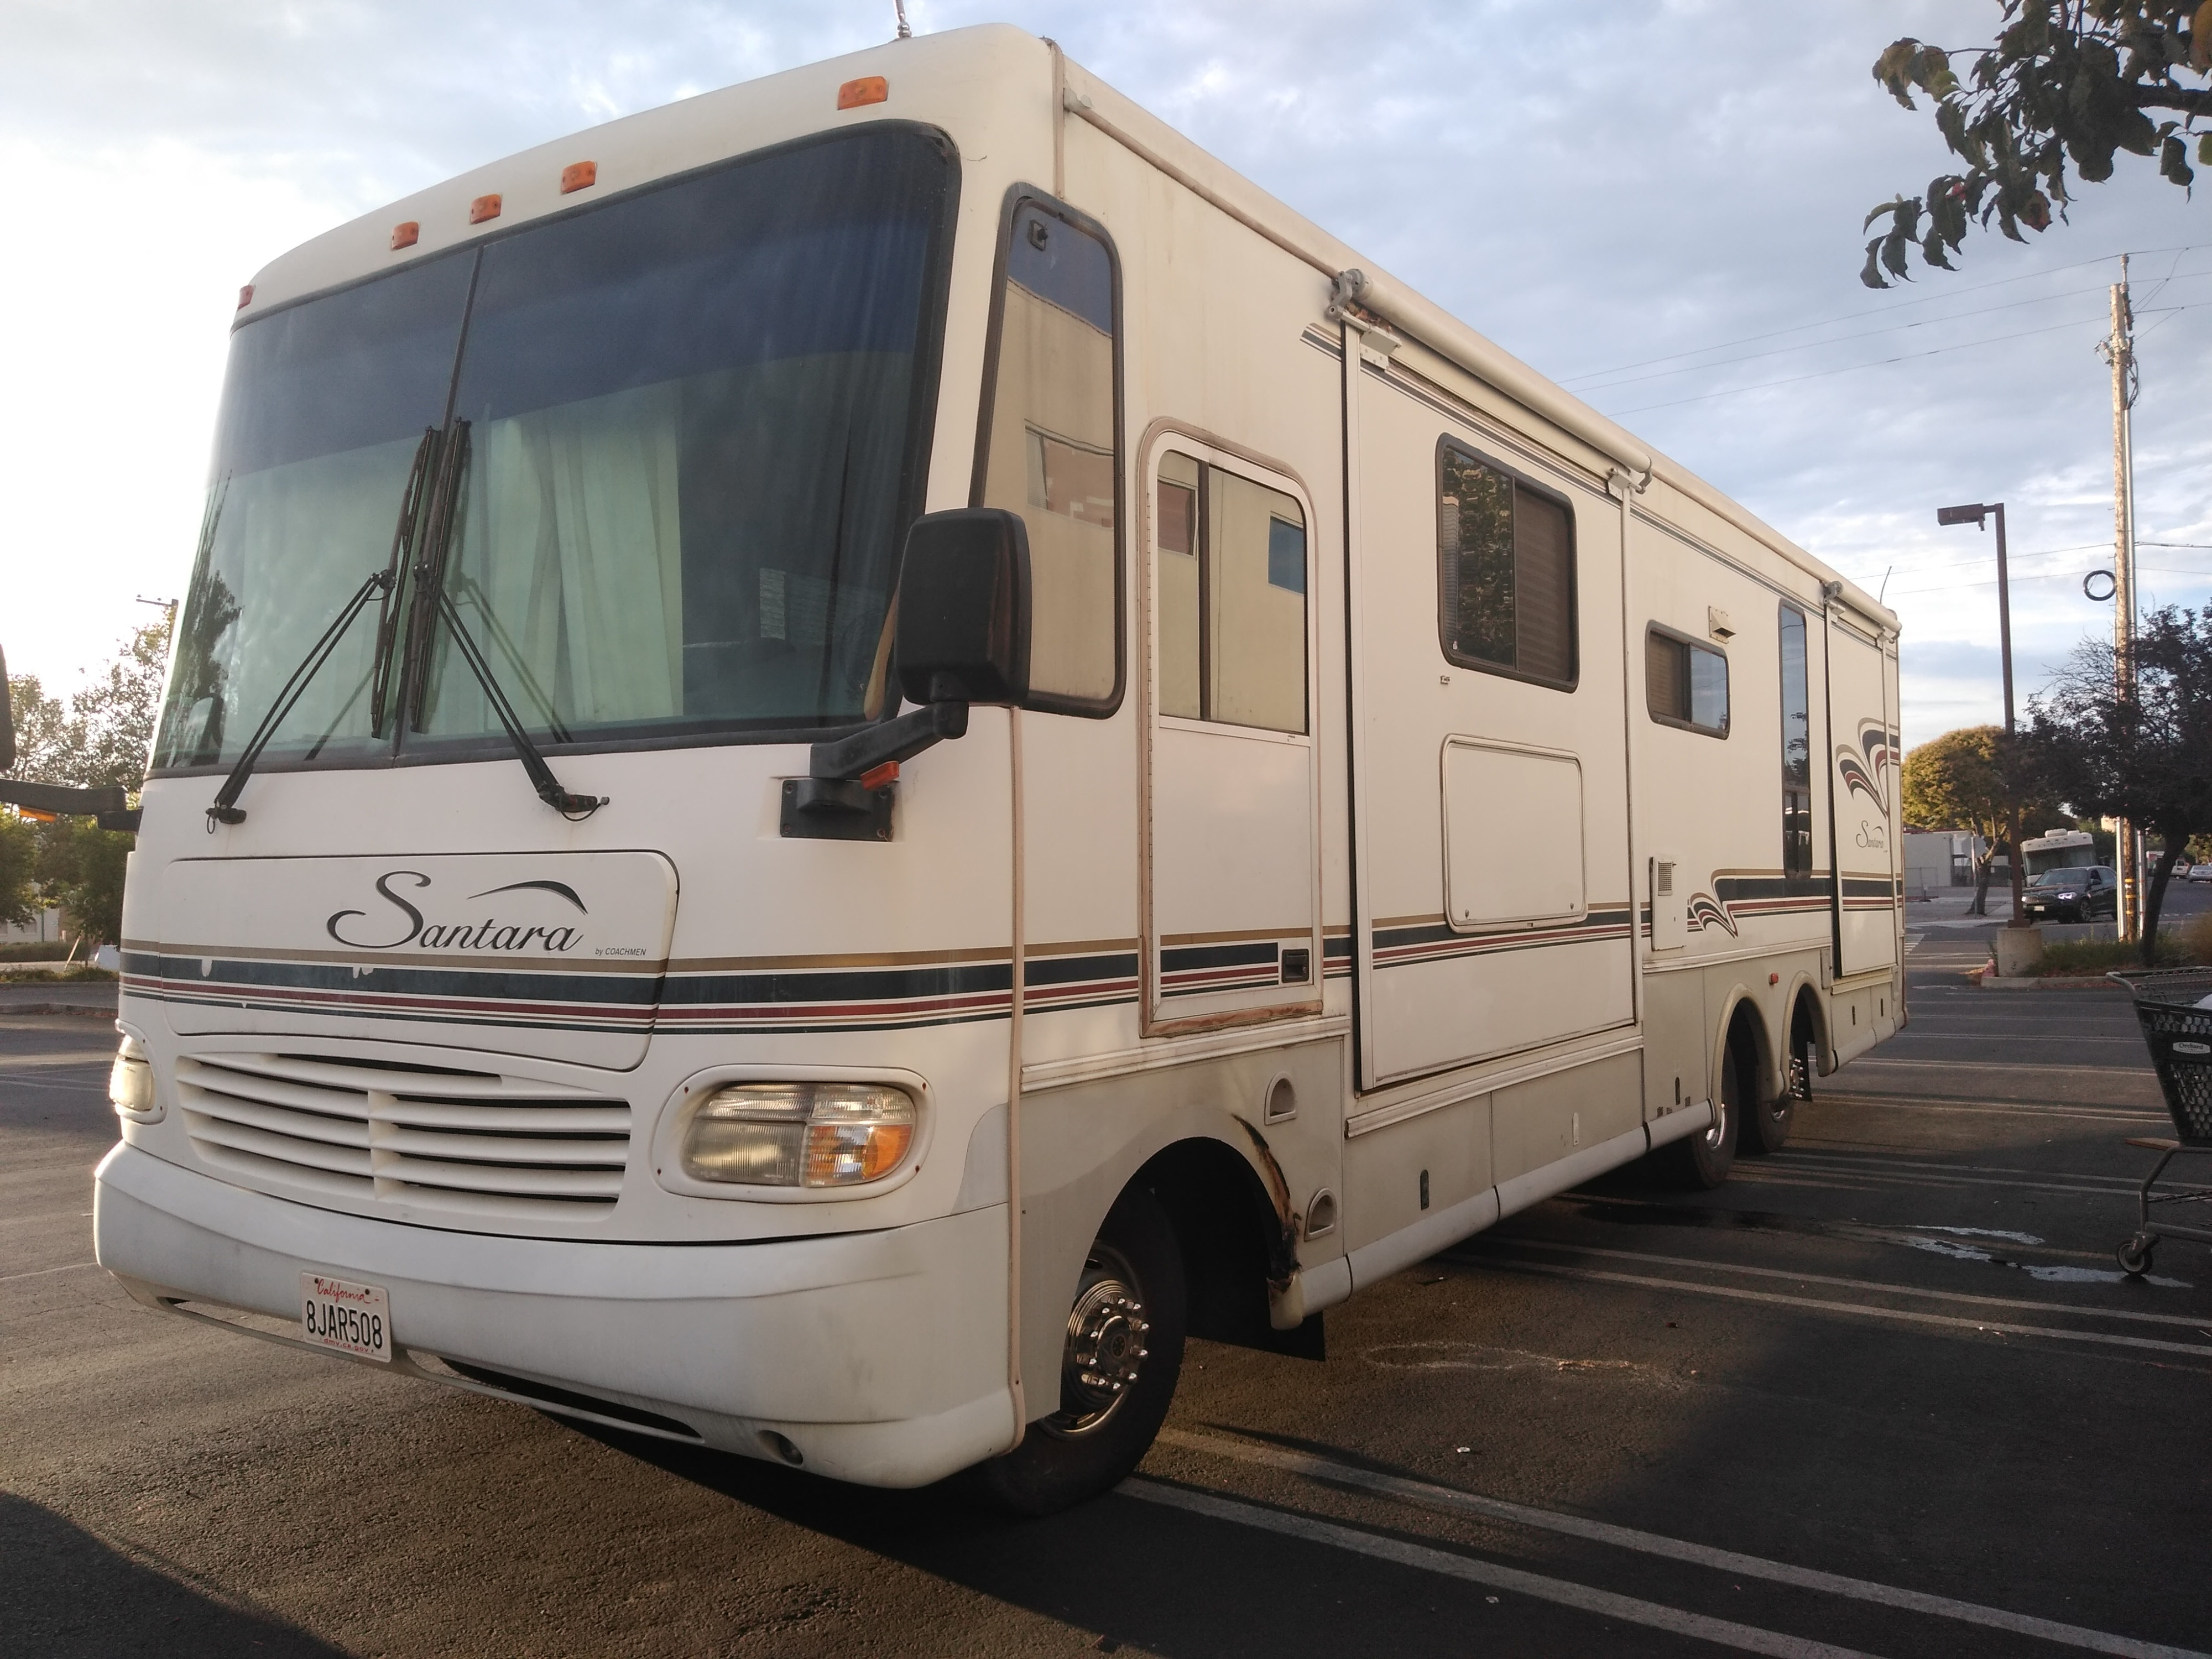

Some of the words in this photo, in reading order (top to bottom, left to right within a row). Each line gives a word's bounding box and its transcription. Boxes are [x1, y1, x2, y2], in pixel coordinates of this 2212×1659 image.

[326, 870, 585, 951] Santara
[595, 947, 603, 956] by
[317, 1279, 371, 1304] California
[306, 1300, 383, 1349] 8JAR508
[324, 1337, 369, 1352] dmv.ca.gov
